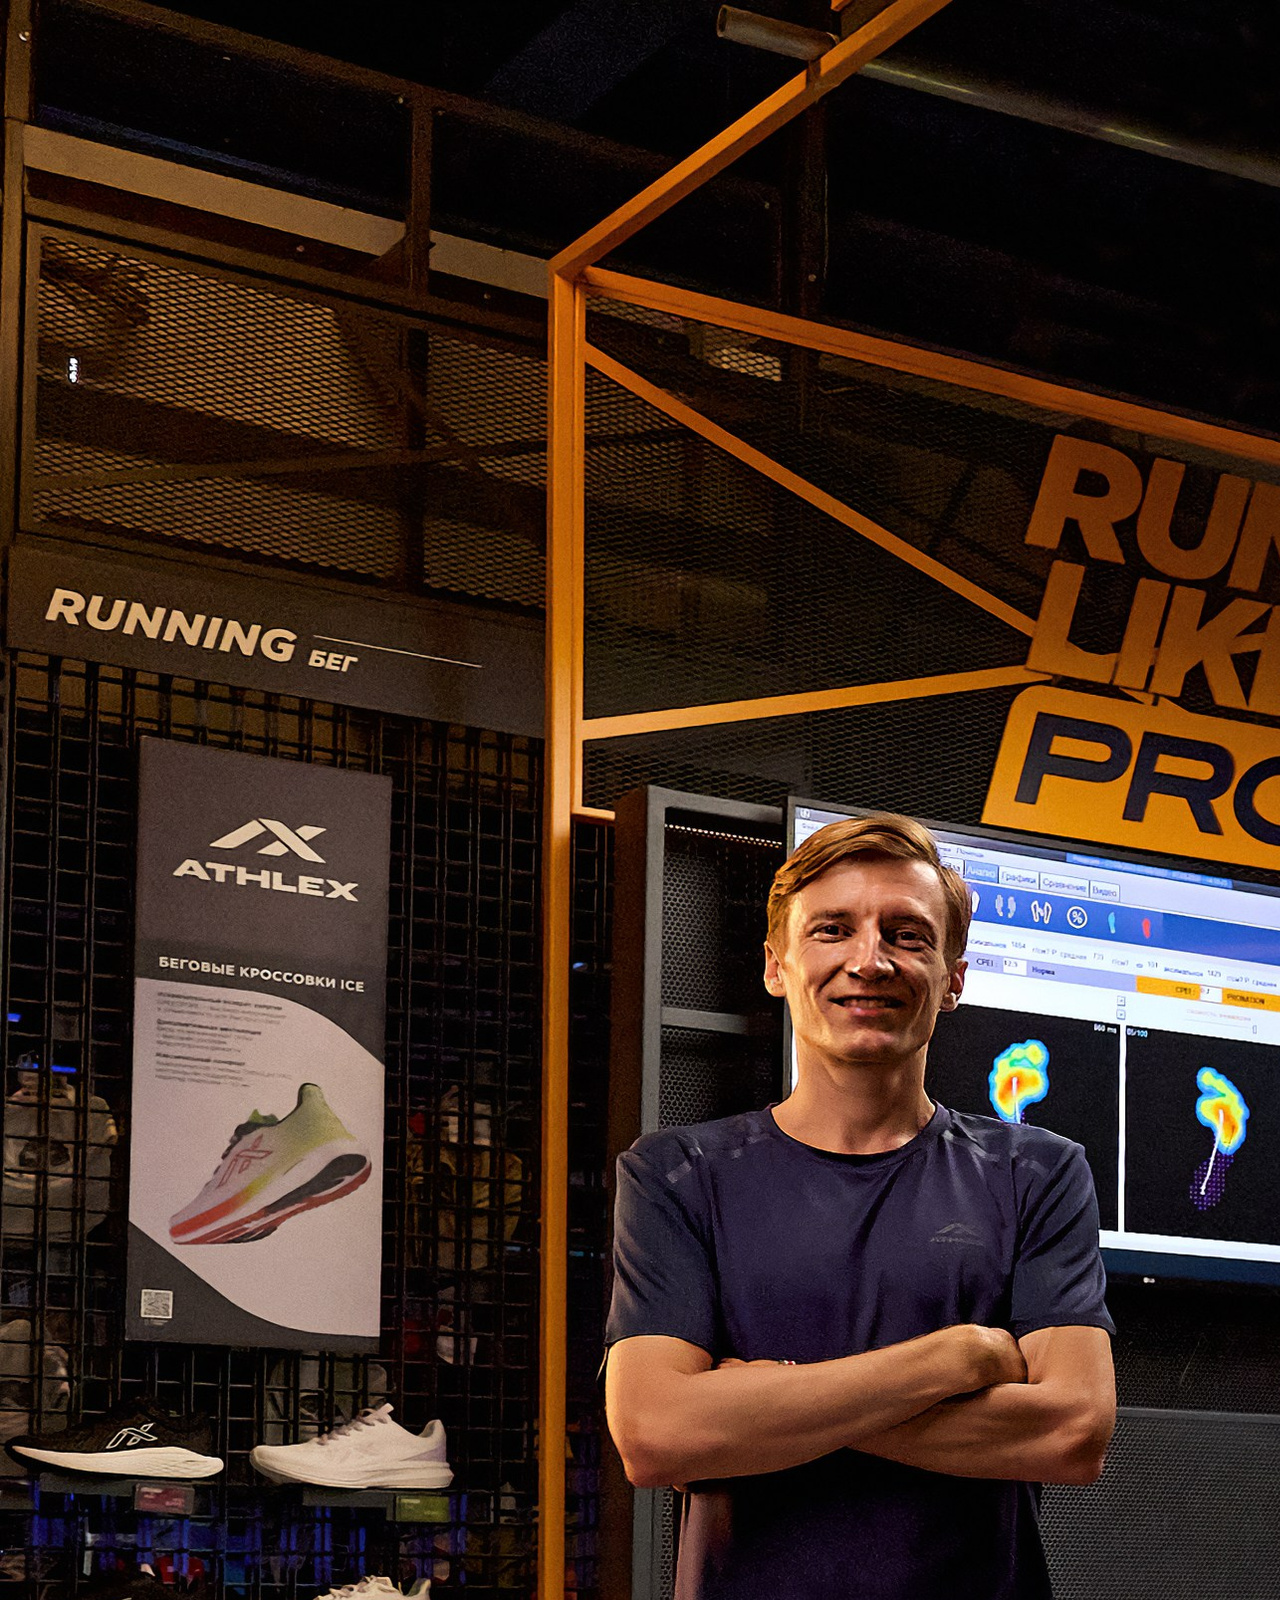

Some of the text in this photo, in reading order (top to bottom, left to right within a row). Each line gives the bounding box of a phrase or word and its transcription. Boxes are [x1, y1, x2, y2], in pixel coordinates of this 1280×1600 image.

[45, 588, 298, 662] RUNNING
[307, 649, 359, 673] БЕГ
[172, 858, 359, 902] ATHLEX
[158, 956, 365, 992] БЕГОВЫЕ КРОССОВКИ ICE
